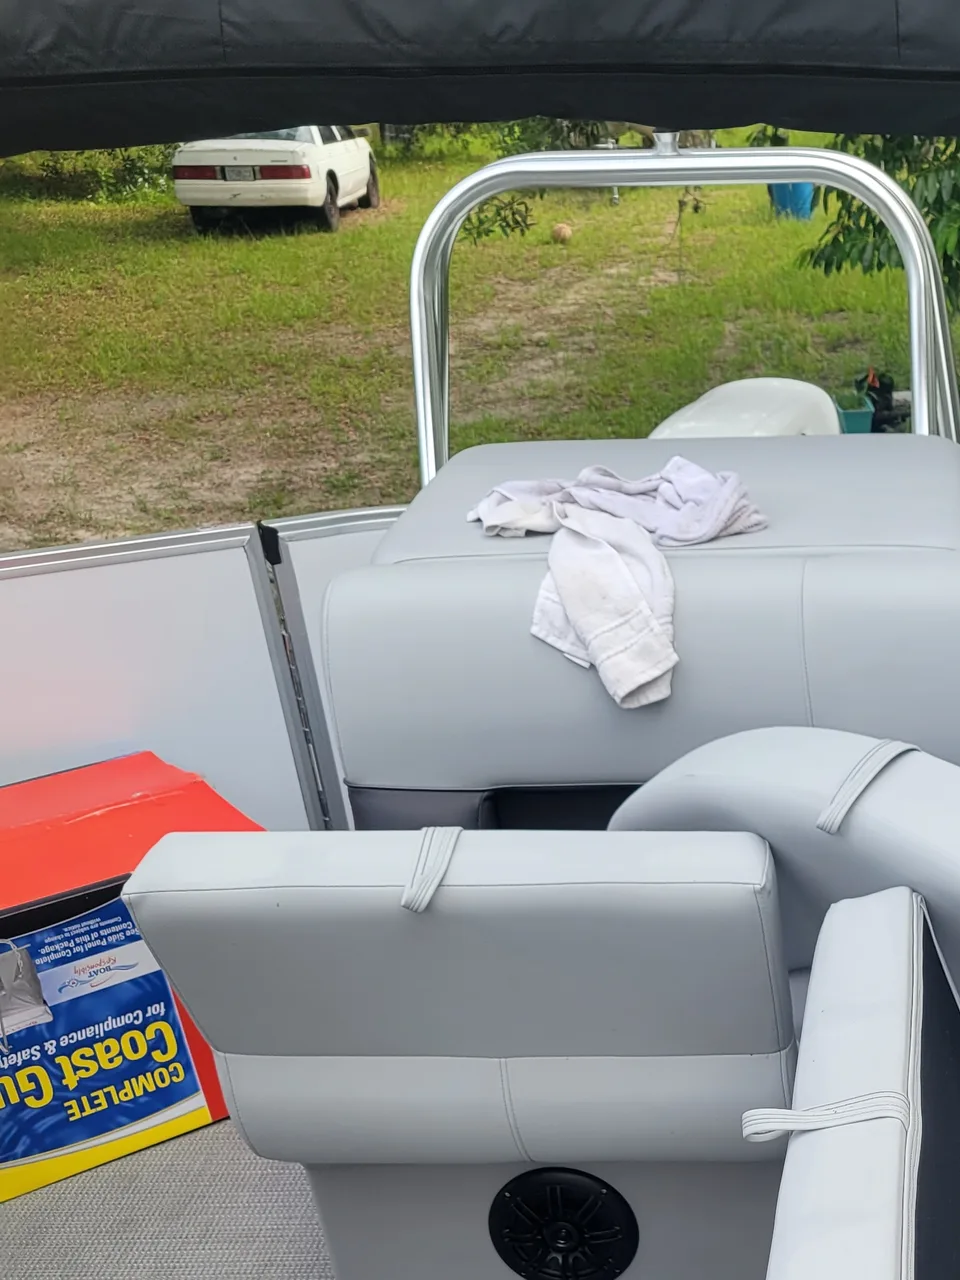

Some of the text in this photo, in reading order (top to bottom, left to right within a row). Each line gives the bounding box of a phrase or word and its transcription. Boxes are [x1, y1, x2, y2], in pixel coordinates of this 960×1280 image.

[38, 921, 133, 955] Contents of this Package.
[84, 937, 107, 951] Panel
[107, 931, 125, 942] Side
[34, 949, 72, 965] Complete
[72, 944, 84, 954] for
[87, 965, 112, 978] BOAT
[145, 1001, 166, 1018] for
[59, 1009, 143, 1047] Compliance
[44, 1039, 57, 1055] &
[54, 1020, 178, 1091] Coast
[63, 1062, 186, 1122] COMPLETE
